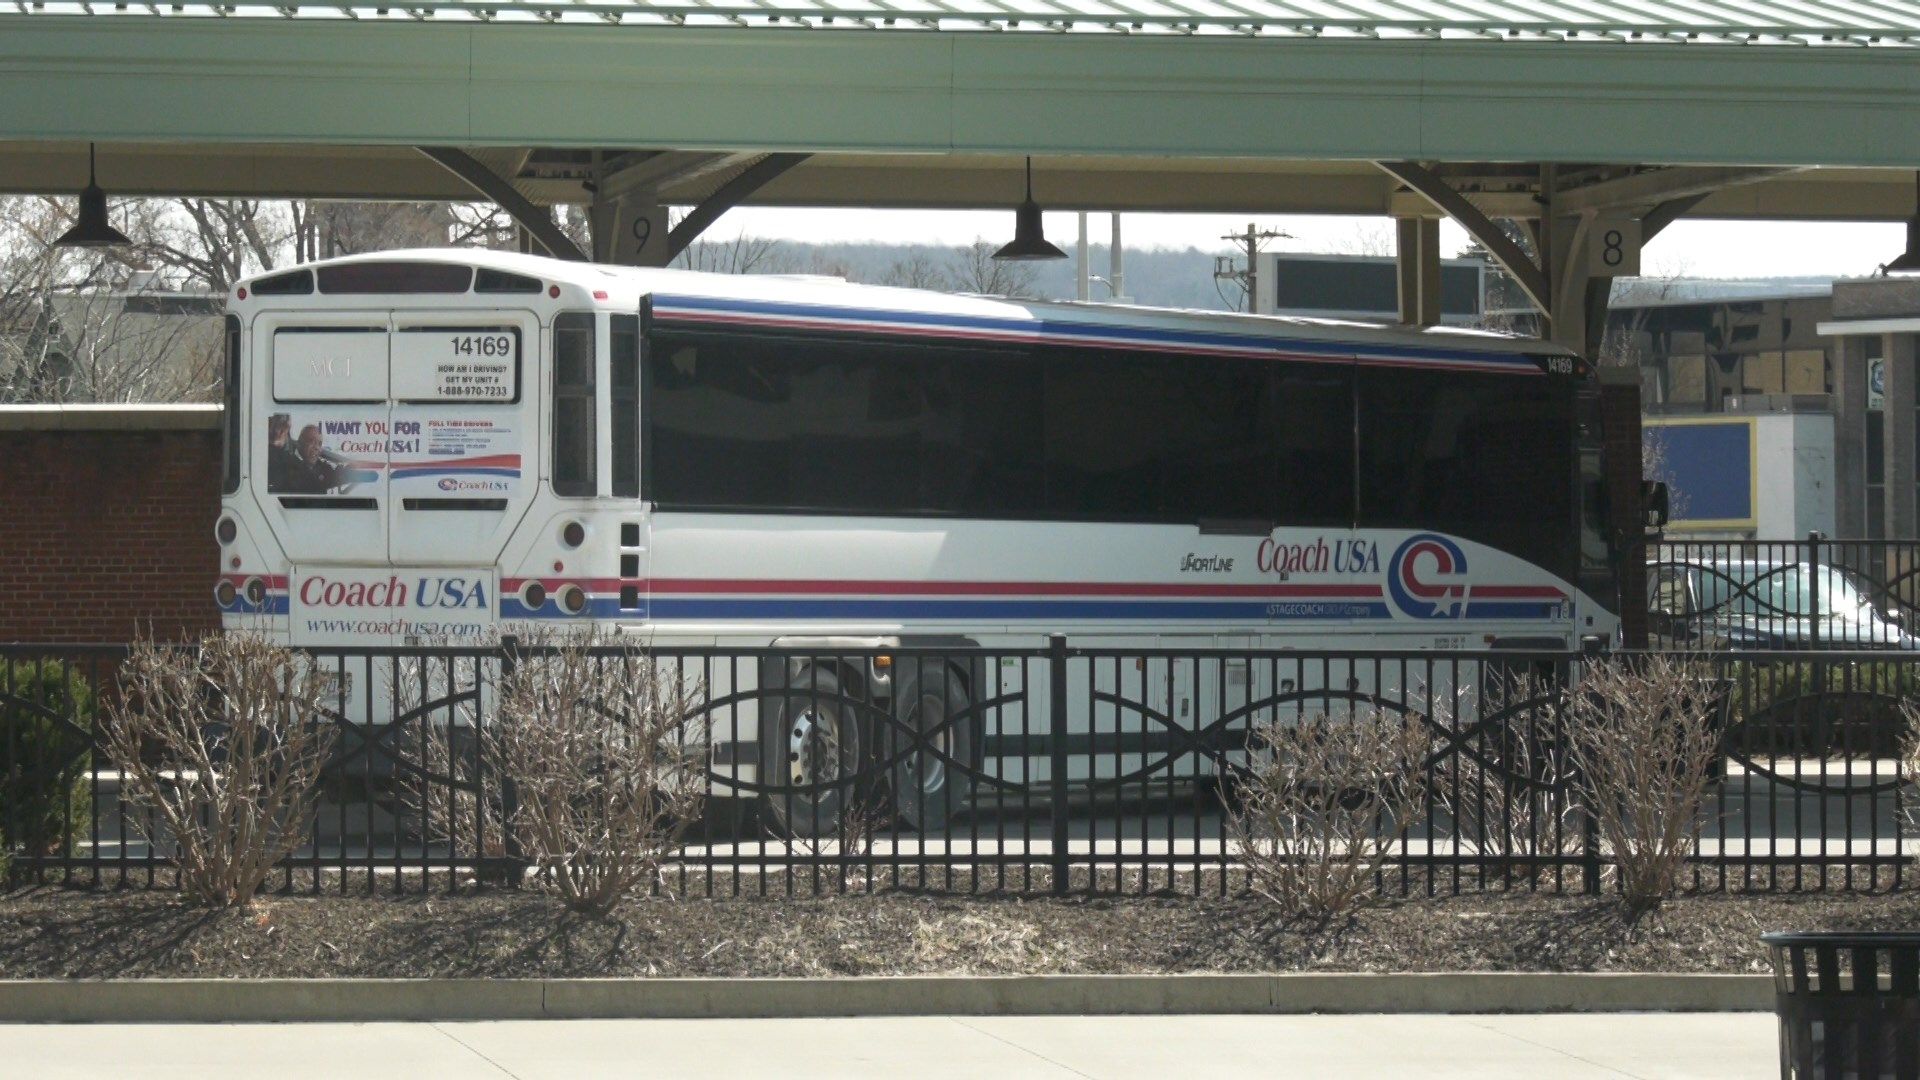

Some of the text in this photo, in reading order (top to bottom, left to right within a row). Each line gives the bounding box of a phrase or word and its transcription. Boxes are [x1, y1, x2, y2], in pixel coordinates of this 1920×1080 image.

[633, 216, 651, 254] 9
[1603, 230, 1623, 267] 8
[451, 336, 510, 356] 14169
[438, 365, 455, 373] HOW
[456, 365, 468, 373] AM
[473, 365, 507, 373] DRIVING?
[1548, 357, 1573, 374] 14169
[438, 386, 507, 396] 1-888-970-7233
[325, 421, 361, 435] WANT
[365, 422, 390, 435] YOU
[394, 422, 420, 435] FOR
[341, 440, 383, 453] Coach
[1257, 536, 1380, 573] Coach USA
[300, 576, 487, 609] Coach USA
[1271, 604, 1324, 614] STAGECOACH
[307, 619, 482, 636] www.coachusa.com
